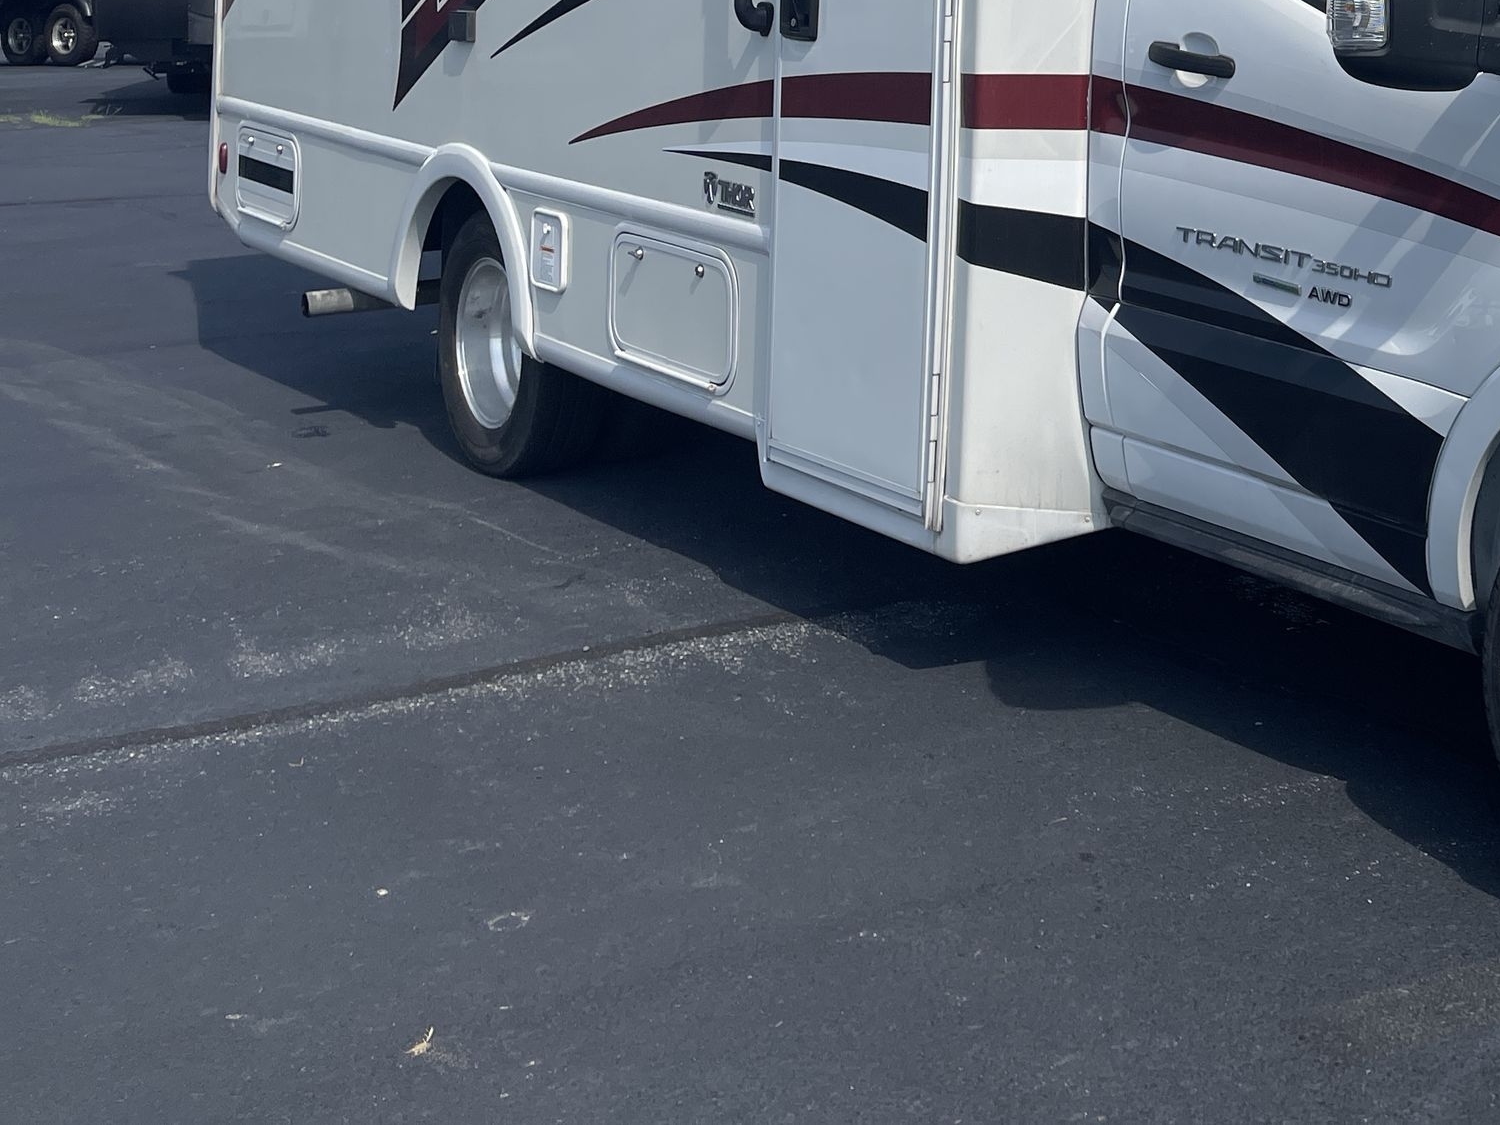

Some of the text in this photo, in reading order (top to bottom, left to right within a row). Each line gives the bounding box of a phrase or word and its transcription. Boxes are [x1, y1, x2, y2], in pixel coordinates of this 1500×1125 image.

[717, 179, 755, 211] THOR
[1176, 225, 1393, 289] TRANSIT 350HD
[1307, 285, 1352, 308] AWD
